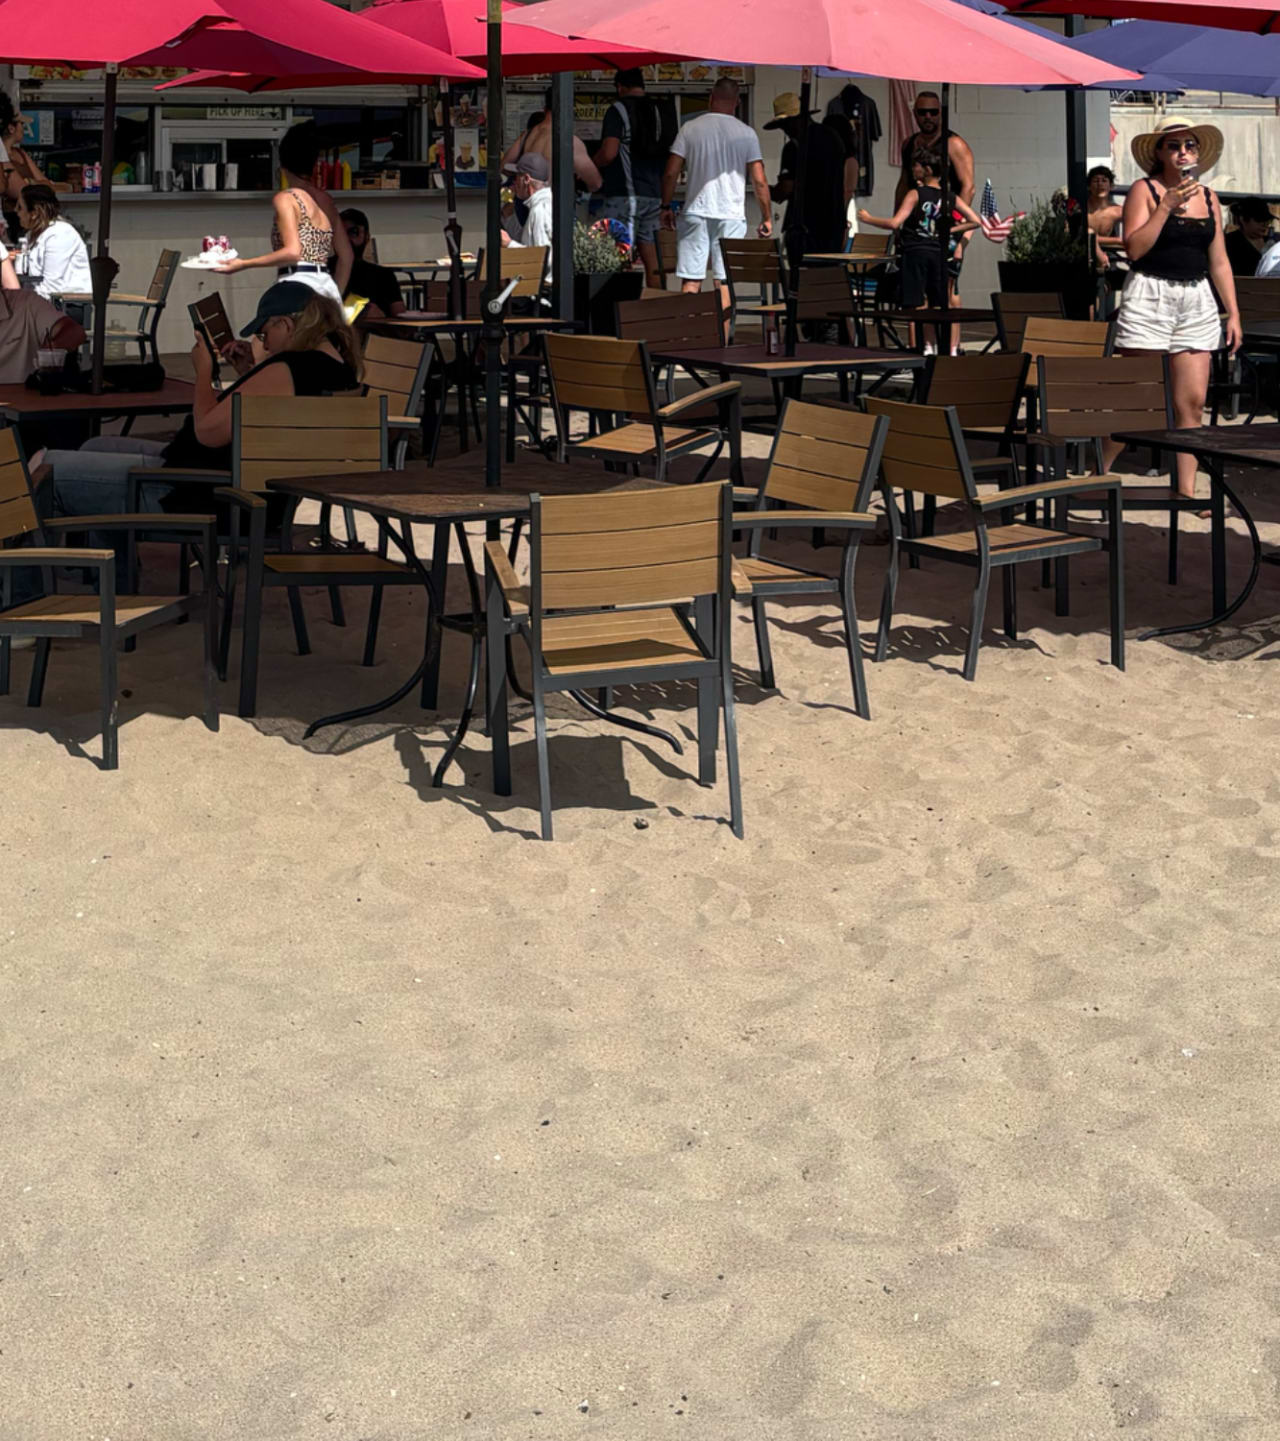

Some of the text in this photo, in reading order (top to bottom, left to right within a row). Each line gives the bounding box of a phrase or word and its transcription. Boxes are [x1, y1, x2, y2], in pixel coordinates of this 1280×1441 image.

[209, 107, 229, 117] PICK
[232, 107, 242, 117] UP
[574, 107, 594, 119] RDER
